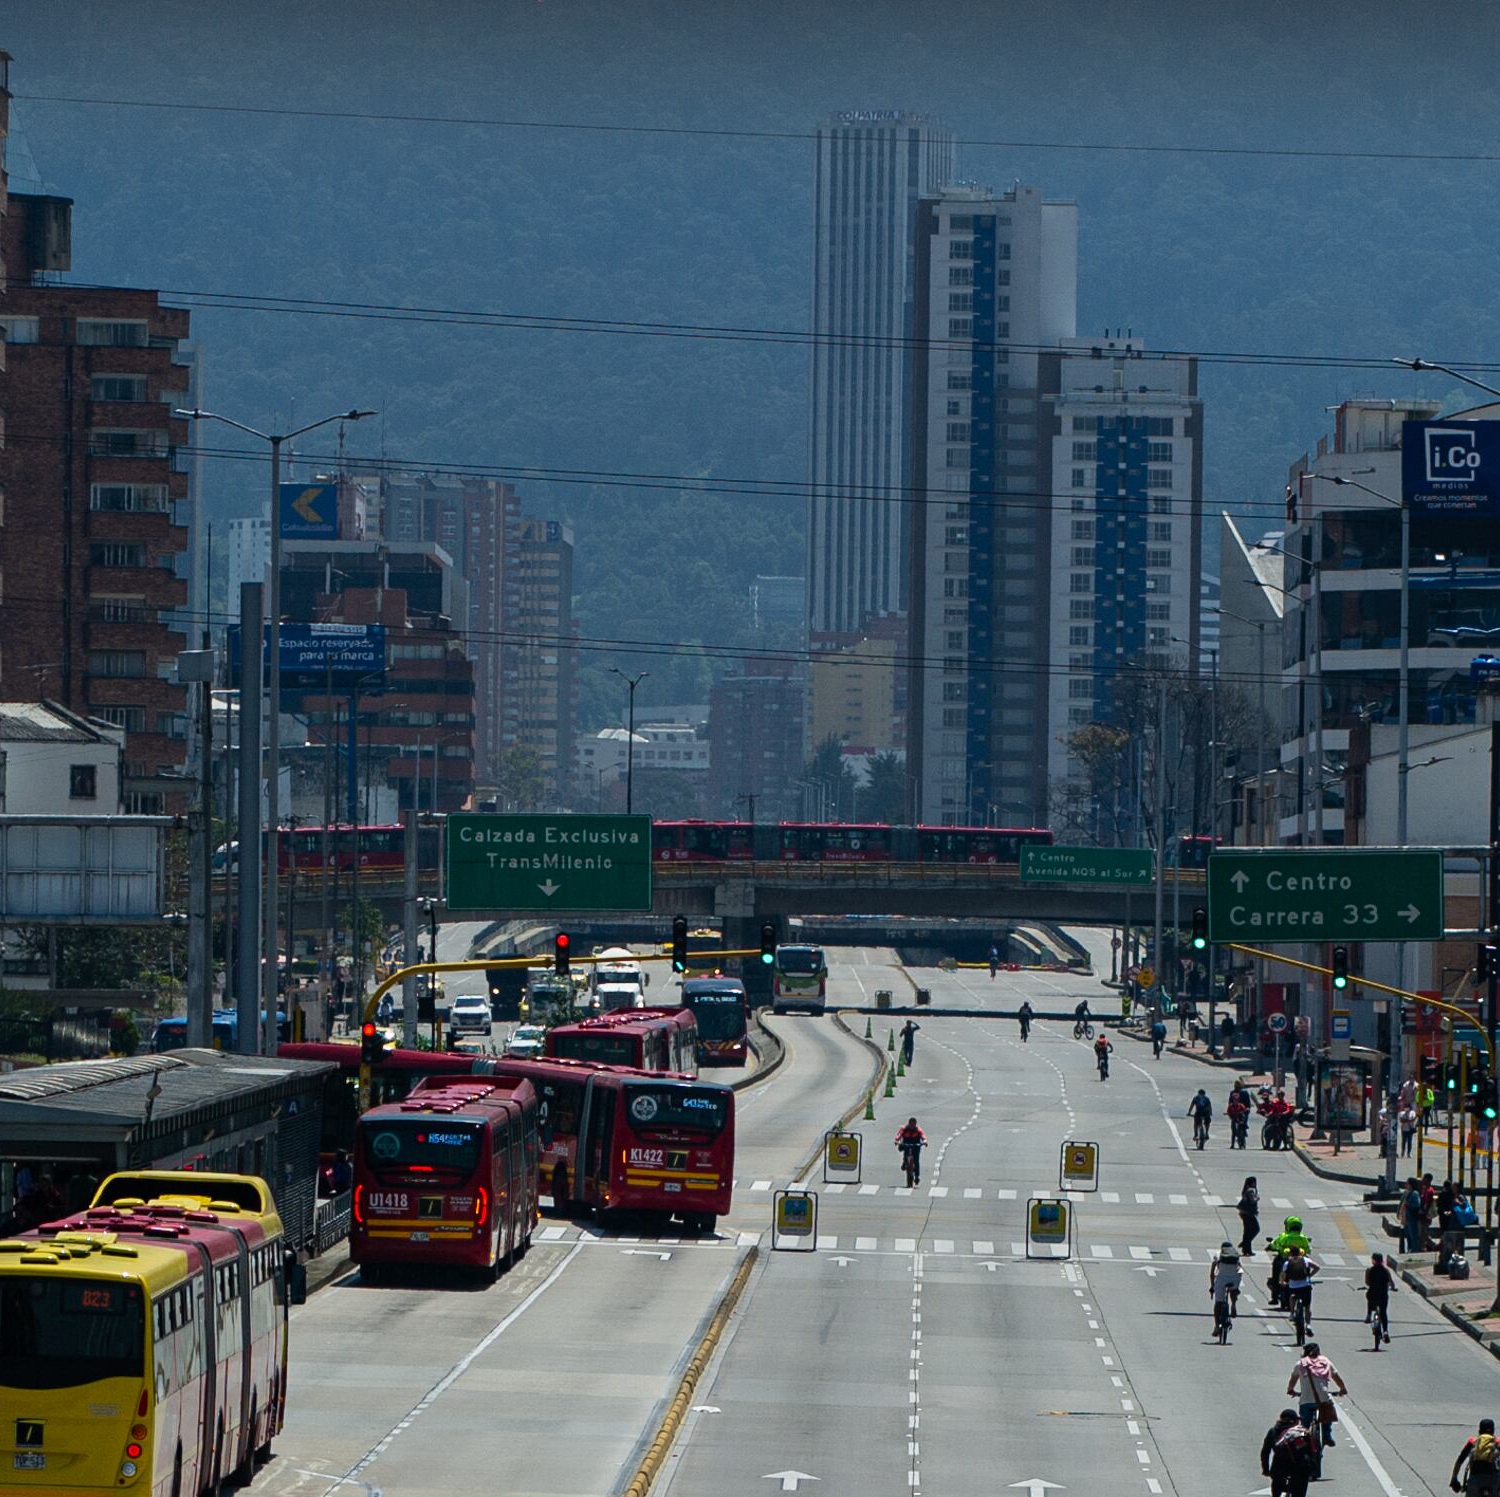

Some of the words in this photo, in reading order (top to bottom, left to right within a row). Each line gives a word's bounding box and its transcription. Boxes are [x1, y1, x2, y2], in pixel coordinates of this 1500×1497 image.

[460, 827, 536, 843] Calzada
[545, 827, 640, 843] Exclusiva
[486, 852, 613, 869] TransMilenio
[1040, 852, 1075, 862] Centro
[1027, 866, 1068, 876] Avenida
[1101, 869, 1110, 877] al
[1114, 868, 1133, 878] Sur
[1266, 870, 1352, 891] Centro
[1229, 906, 1324, 926] Carrera
[1343, 904, 1379, 924] 33
[1271, 1016, 1285, 1028] 50
[289, 1101, 298, 1114] A
[631, 1148, 663, 1162] K1422
[369, 1193, 408, 1207] U1418
